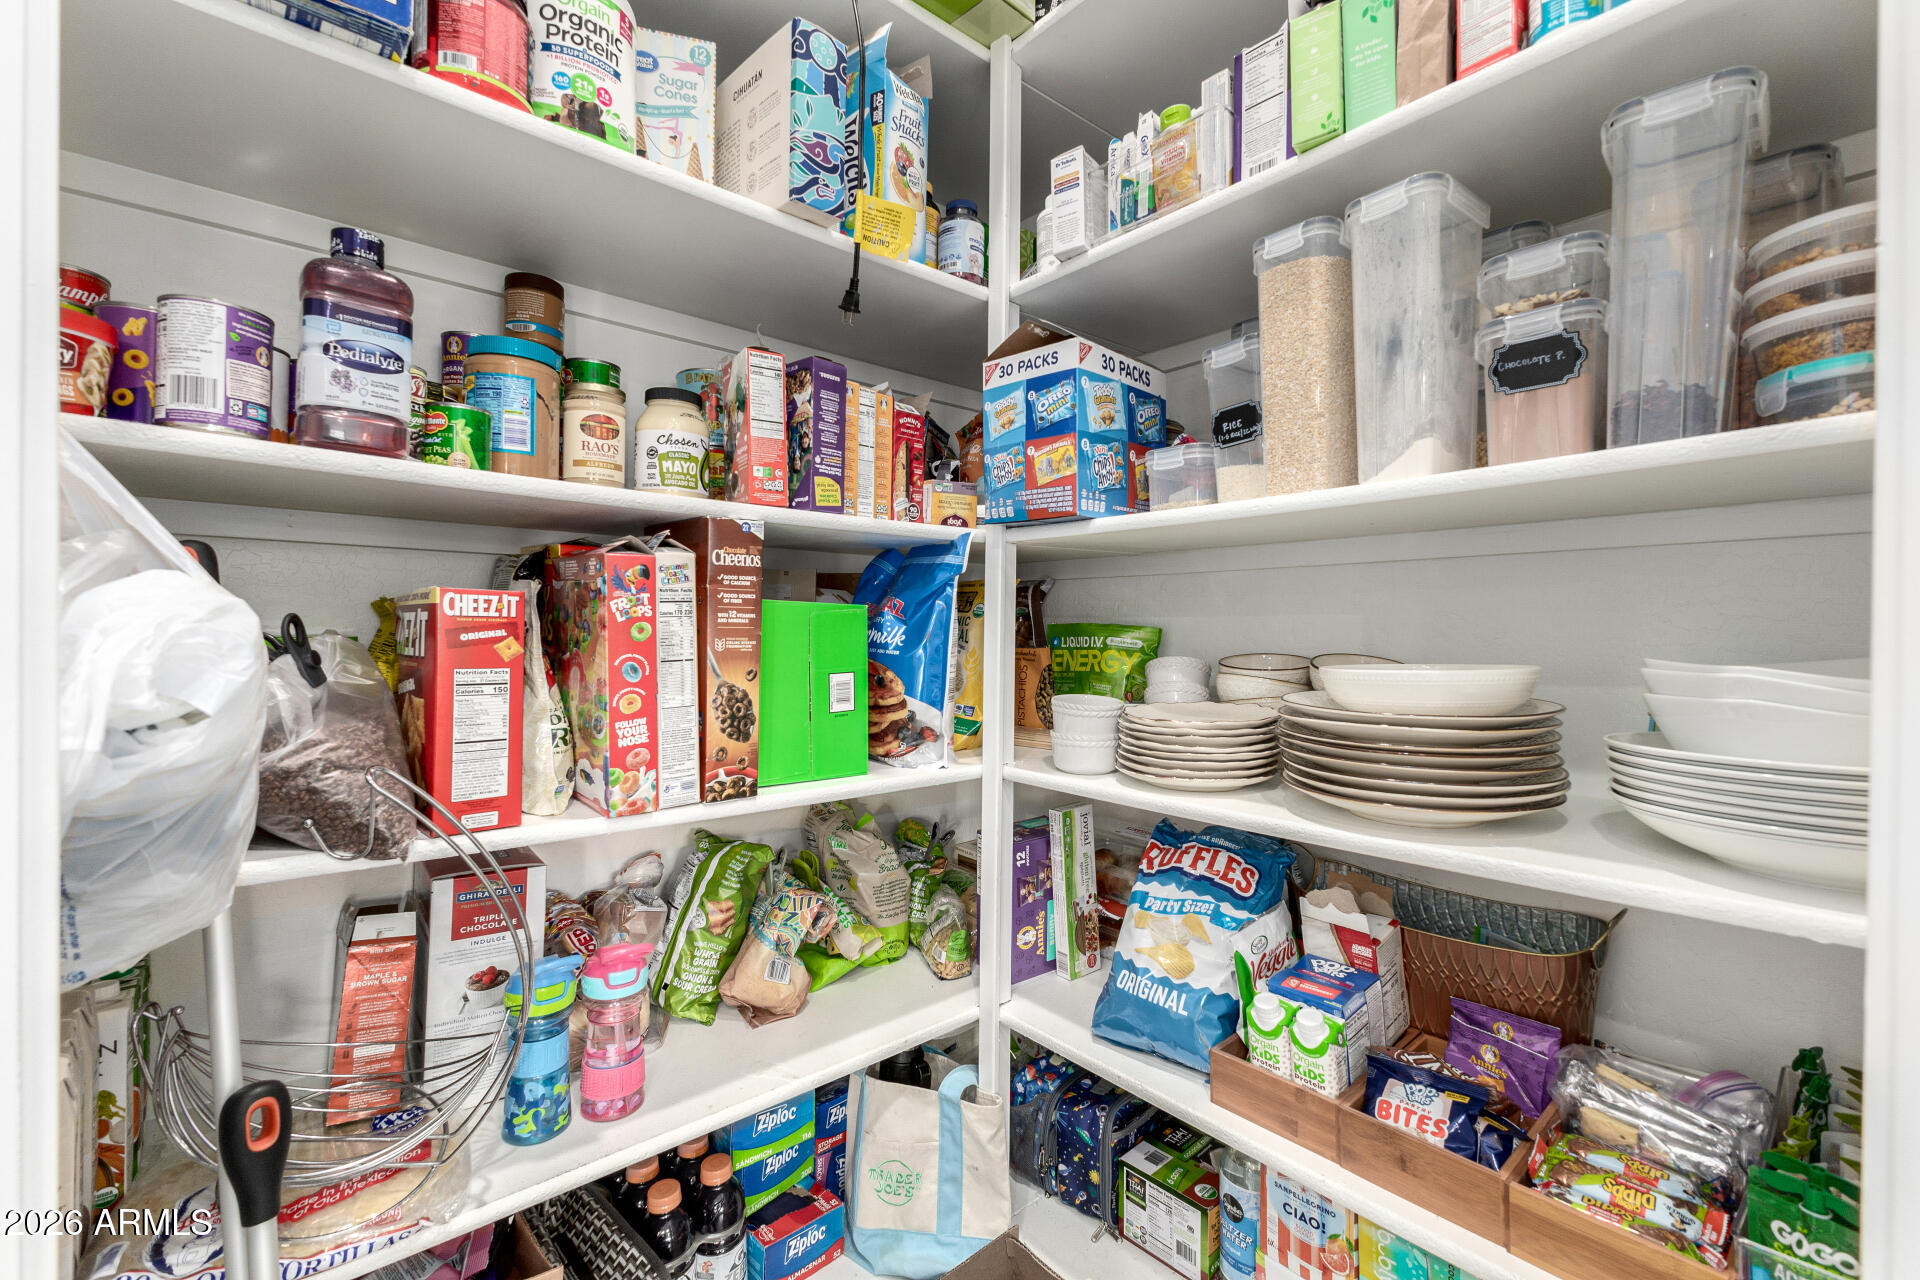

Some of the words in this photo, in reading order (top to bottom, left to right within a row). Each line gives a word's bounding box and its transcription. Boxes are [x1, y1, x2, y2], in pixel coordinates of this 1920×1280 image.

[539, 3, 623, 53] Organic
[546, 23, 619, 67] Protein
[694, 47, 707, 59] 12
[658, 73, 699, 91] Sugar
[654, 86, 698, 104] Cones
[899, 109, 921, 132] Fruit
[891, 116, 925, 148] Snacks
[862, 234, 890, 248] CAUTION
[327, 342, 402, 371] Pedialyte
[998, 363, 1013, 379] 30
[1017, 351, 1059, 376] PACKS
[1498, 354, 1551, 372] CHOCOLATE
[1101, 353, 1115, 374] 30
[1119, 361, 1151, 387] PACKS
[1037, 387, 1071, 412] OREO
[1047, 396, 1069, 416] mini
[1137, 408, 1159, 422] OREO
[1222, 419, 1242, 432] RICE
[433, 446, 451, 454] PEAS
[581, 440, 619, 455] RAO'S
[656, 433, 699, 449] Chosen
[662, 461, 697, 475] MAYO
[712, 549, 761, 567] Cheerios
[609, 593, 651, 612] FROOT
[615, 606, 652, 623] LOOPS
[460, 629, 507, 641] ORIGINAL
[1061, 636, 1089, 648] LIQUID
[1051, 650, 1142, 675] ENERGY
[1017, 664, 1028, 727] PISTACHIOS
[615, 717, 647, 731] FOLLOW
[617, 727, 648, 740] YOUR
[617, 735, 649, 749] NOSE
[1016, 850, 1026, 867] 12
[1139, 841, 1257, 893] RUFFLES
[459, 886, 521, 901] GHIRADELI
[1144, 895, 1180, 913] Party
[1182, 898, 1215, 914] Size!
[460, 918, 517, 934] CHOCOLAE
[1036, 910, 1046, 956] Annie's
[470, 935, 507, 947] INDULGE
[692, 958, 718, 968] GRAIN
[363, 971, 391, 980] MAPLE
[382, 976, 407, 984] SUGAR
[672, 978, 693, 992] SOUR
[1116, 969, 1189, 1016] ORIGINAL
[1250, 1055, 1281, 1072] protein
[1469, 1054, 1508, 1079] Annie's
[1294, 1073, 1326, 1091] protein
[757, 1104, 797, 1131] Ziploc
[1376, 1099, 1449, 1139] BITES
[817, 1133, 843, 1148] STORAGE
[735, 1148, 773, 1169] SANDWICH
[765, 1145, 799, 1175] Ziploc
[870, 1166, 922, 1186] TRADER
[874, 1182, 914, 1198] JOE'S
[746, 1189, 779, 1218] SANDWICH
[1274, 1180, 1337, 1219] SANPELLEGRINO
[1282, 1202, 1326, 1235] CIAO!
[787, 1227, 826, 1256] Ziploc
[787, 1254, 826, 1280] ALMACENAR
